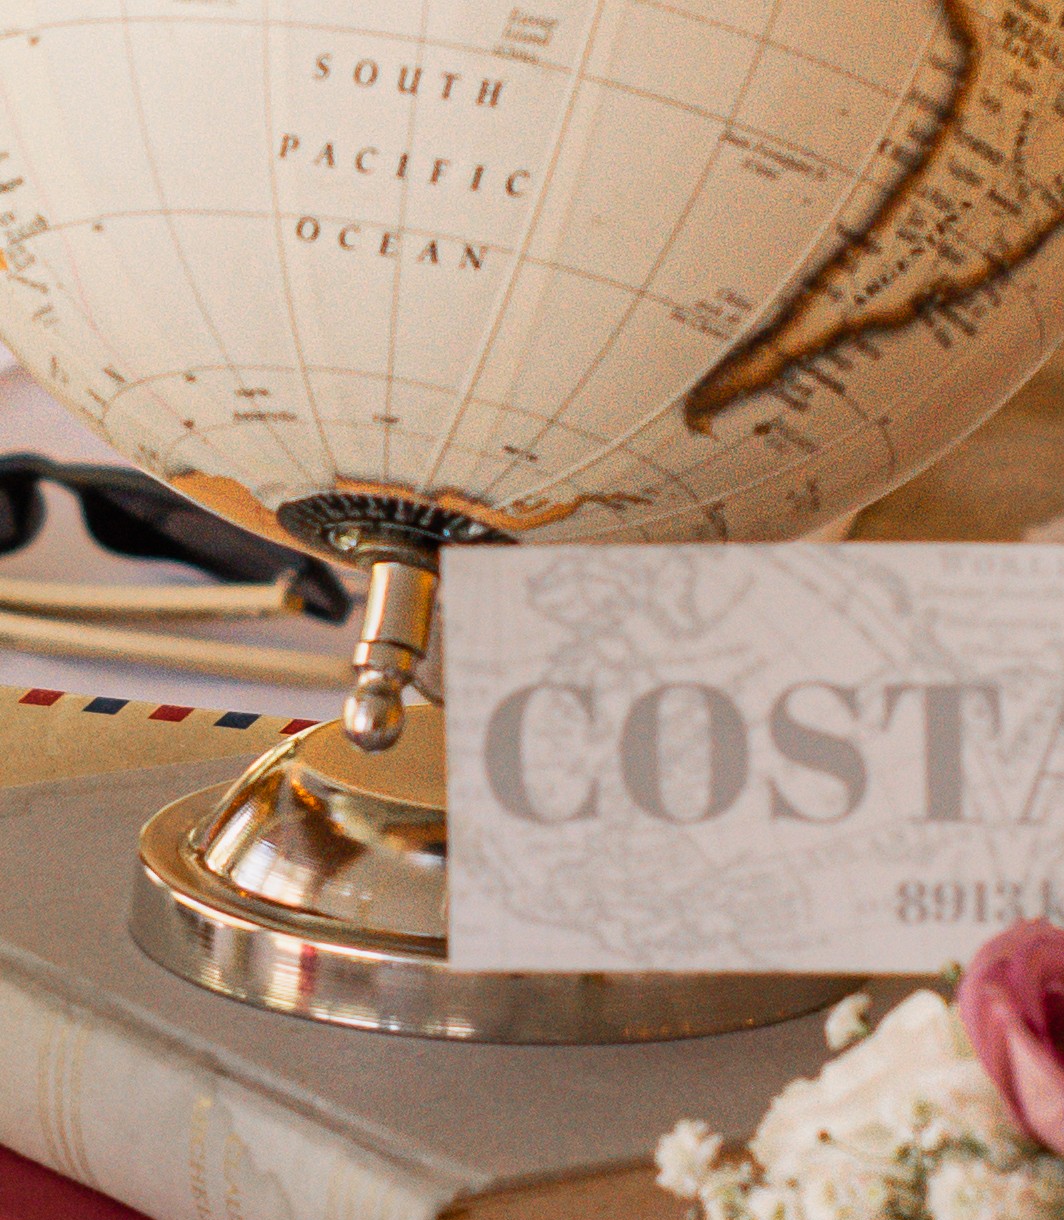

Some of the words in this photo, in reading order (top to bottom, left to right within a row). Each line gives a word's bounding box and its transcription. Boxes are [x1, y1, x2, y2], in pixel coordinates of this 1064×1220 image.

[311, 52, 507, 109] SOUTH
[278, 133, 534, 199] PACIFIC
[294, 215, 489, 271] OCEAN
[895, 879, 1026, 925] 8913
